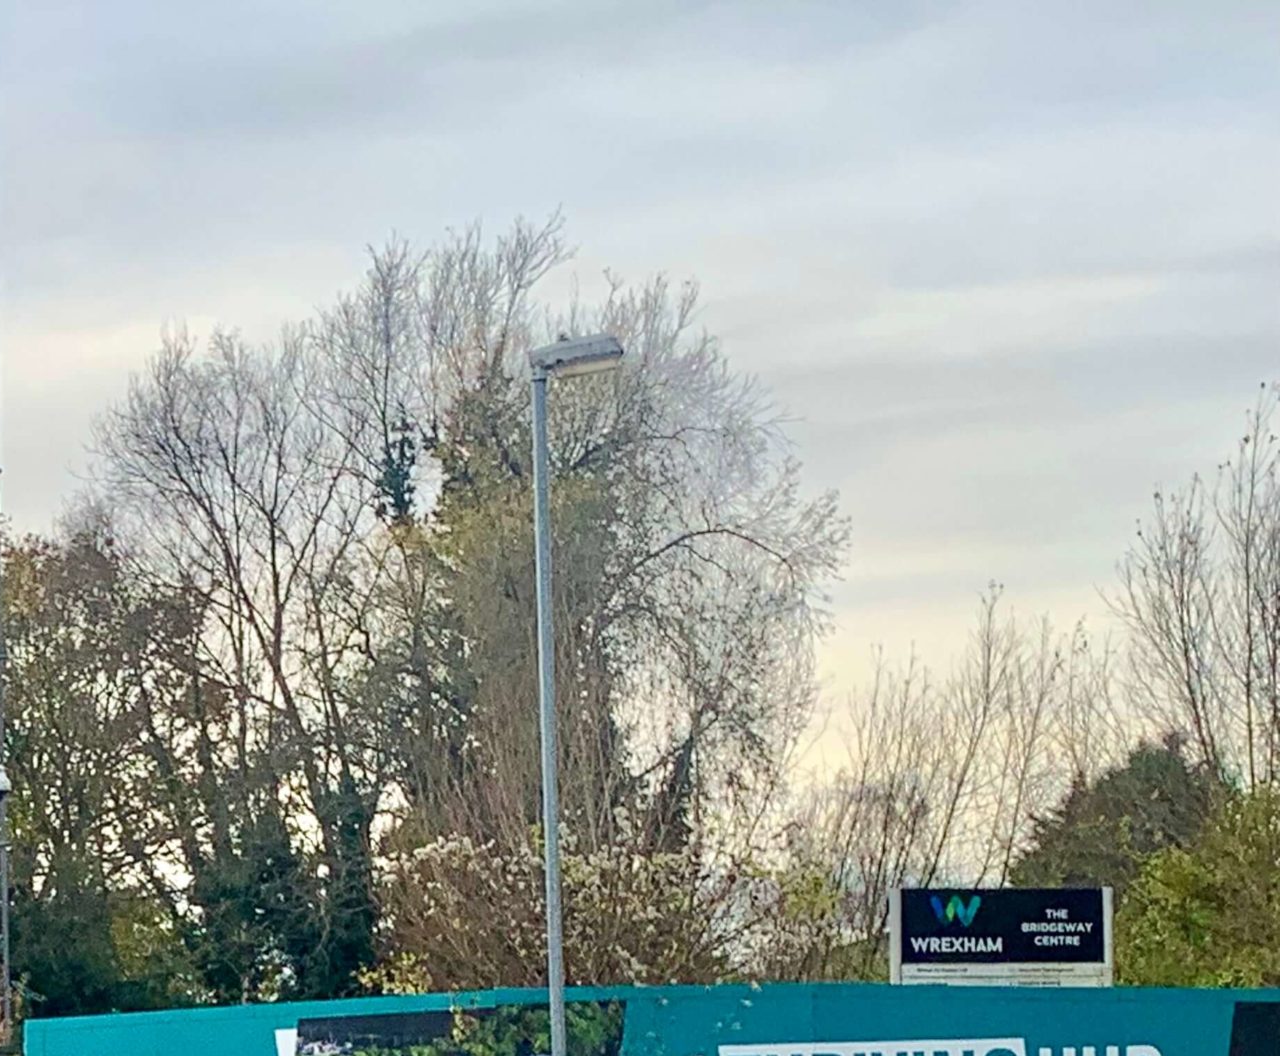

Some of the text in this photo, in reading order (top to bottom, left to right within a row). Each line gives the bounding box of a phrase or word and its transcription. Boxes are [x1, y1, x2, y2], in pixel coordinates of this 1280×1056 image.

[1045, 908, 1069, 919] THE
[1020, 921, 1093, 933] BRIDGEWAY
[910, 936, 1003, 953] WREXHAM
[1033, 935, 1081, 947] CENTRE
